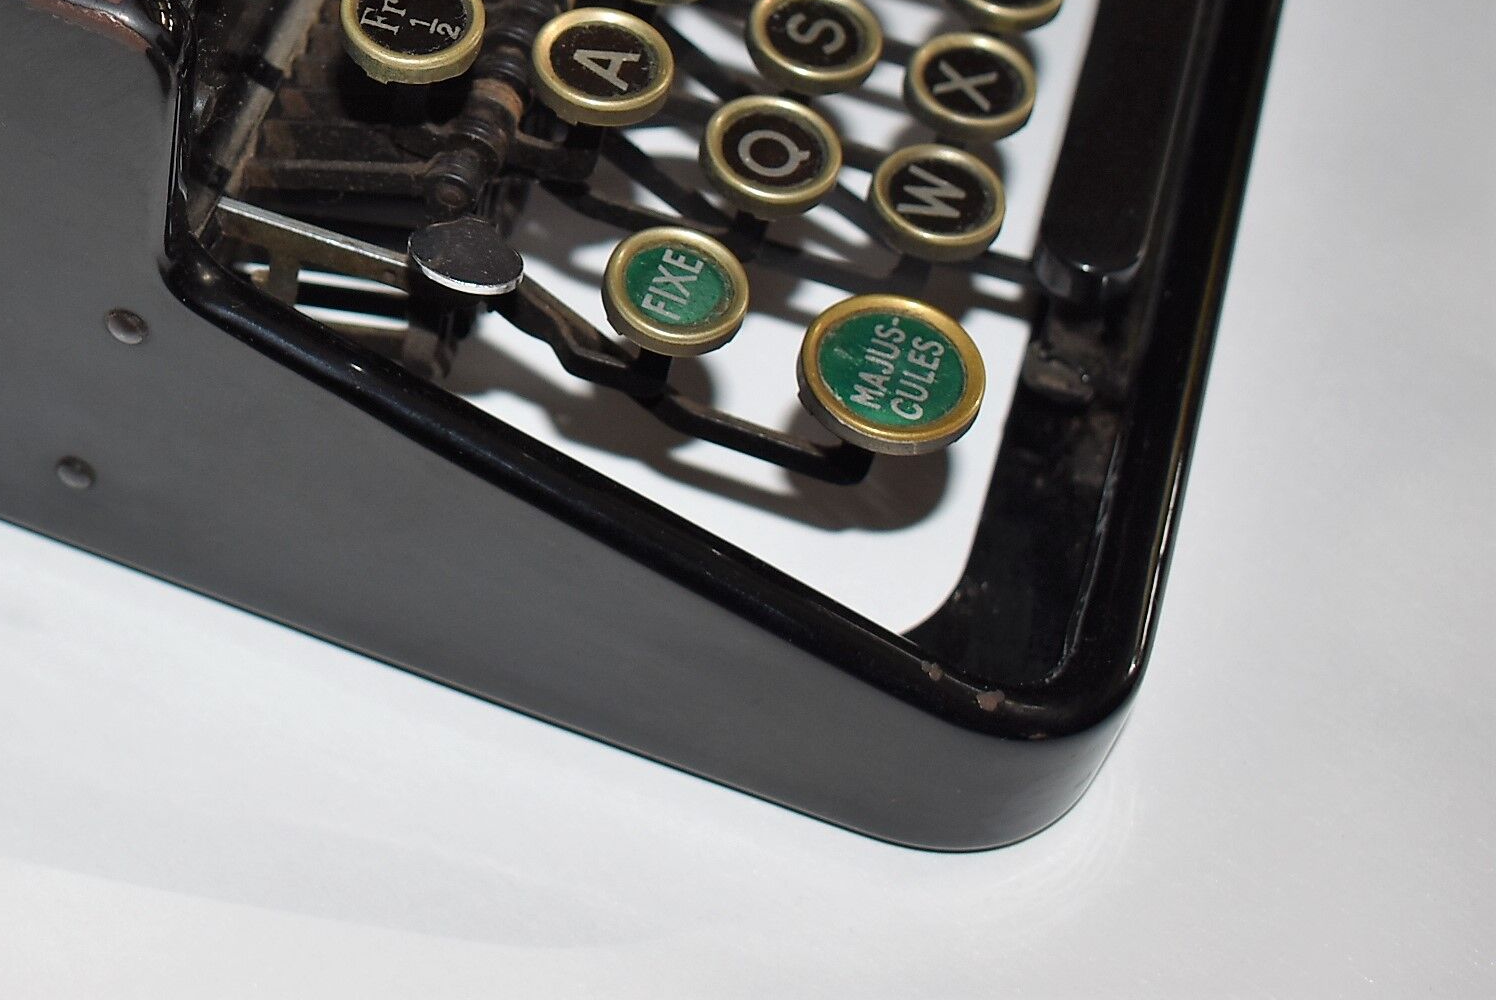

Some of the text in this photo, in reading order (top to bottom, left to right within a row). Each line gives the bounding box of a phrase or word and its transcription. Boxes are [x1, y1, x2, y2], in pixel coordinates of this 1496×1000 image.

[785, 12, 847, 56] S
[573, 48, 641, 92] A
[932, 59, 999, 113] X
[736, 129, 811, 178] Q
[895, 163, 967, 219] W
[640, 248, 705, 321] FIXE
[849, 316, 907, 411] MAJUS-
[890, 335, 946, 421] CULES
